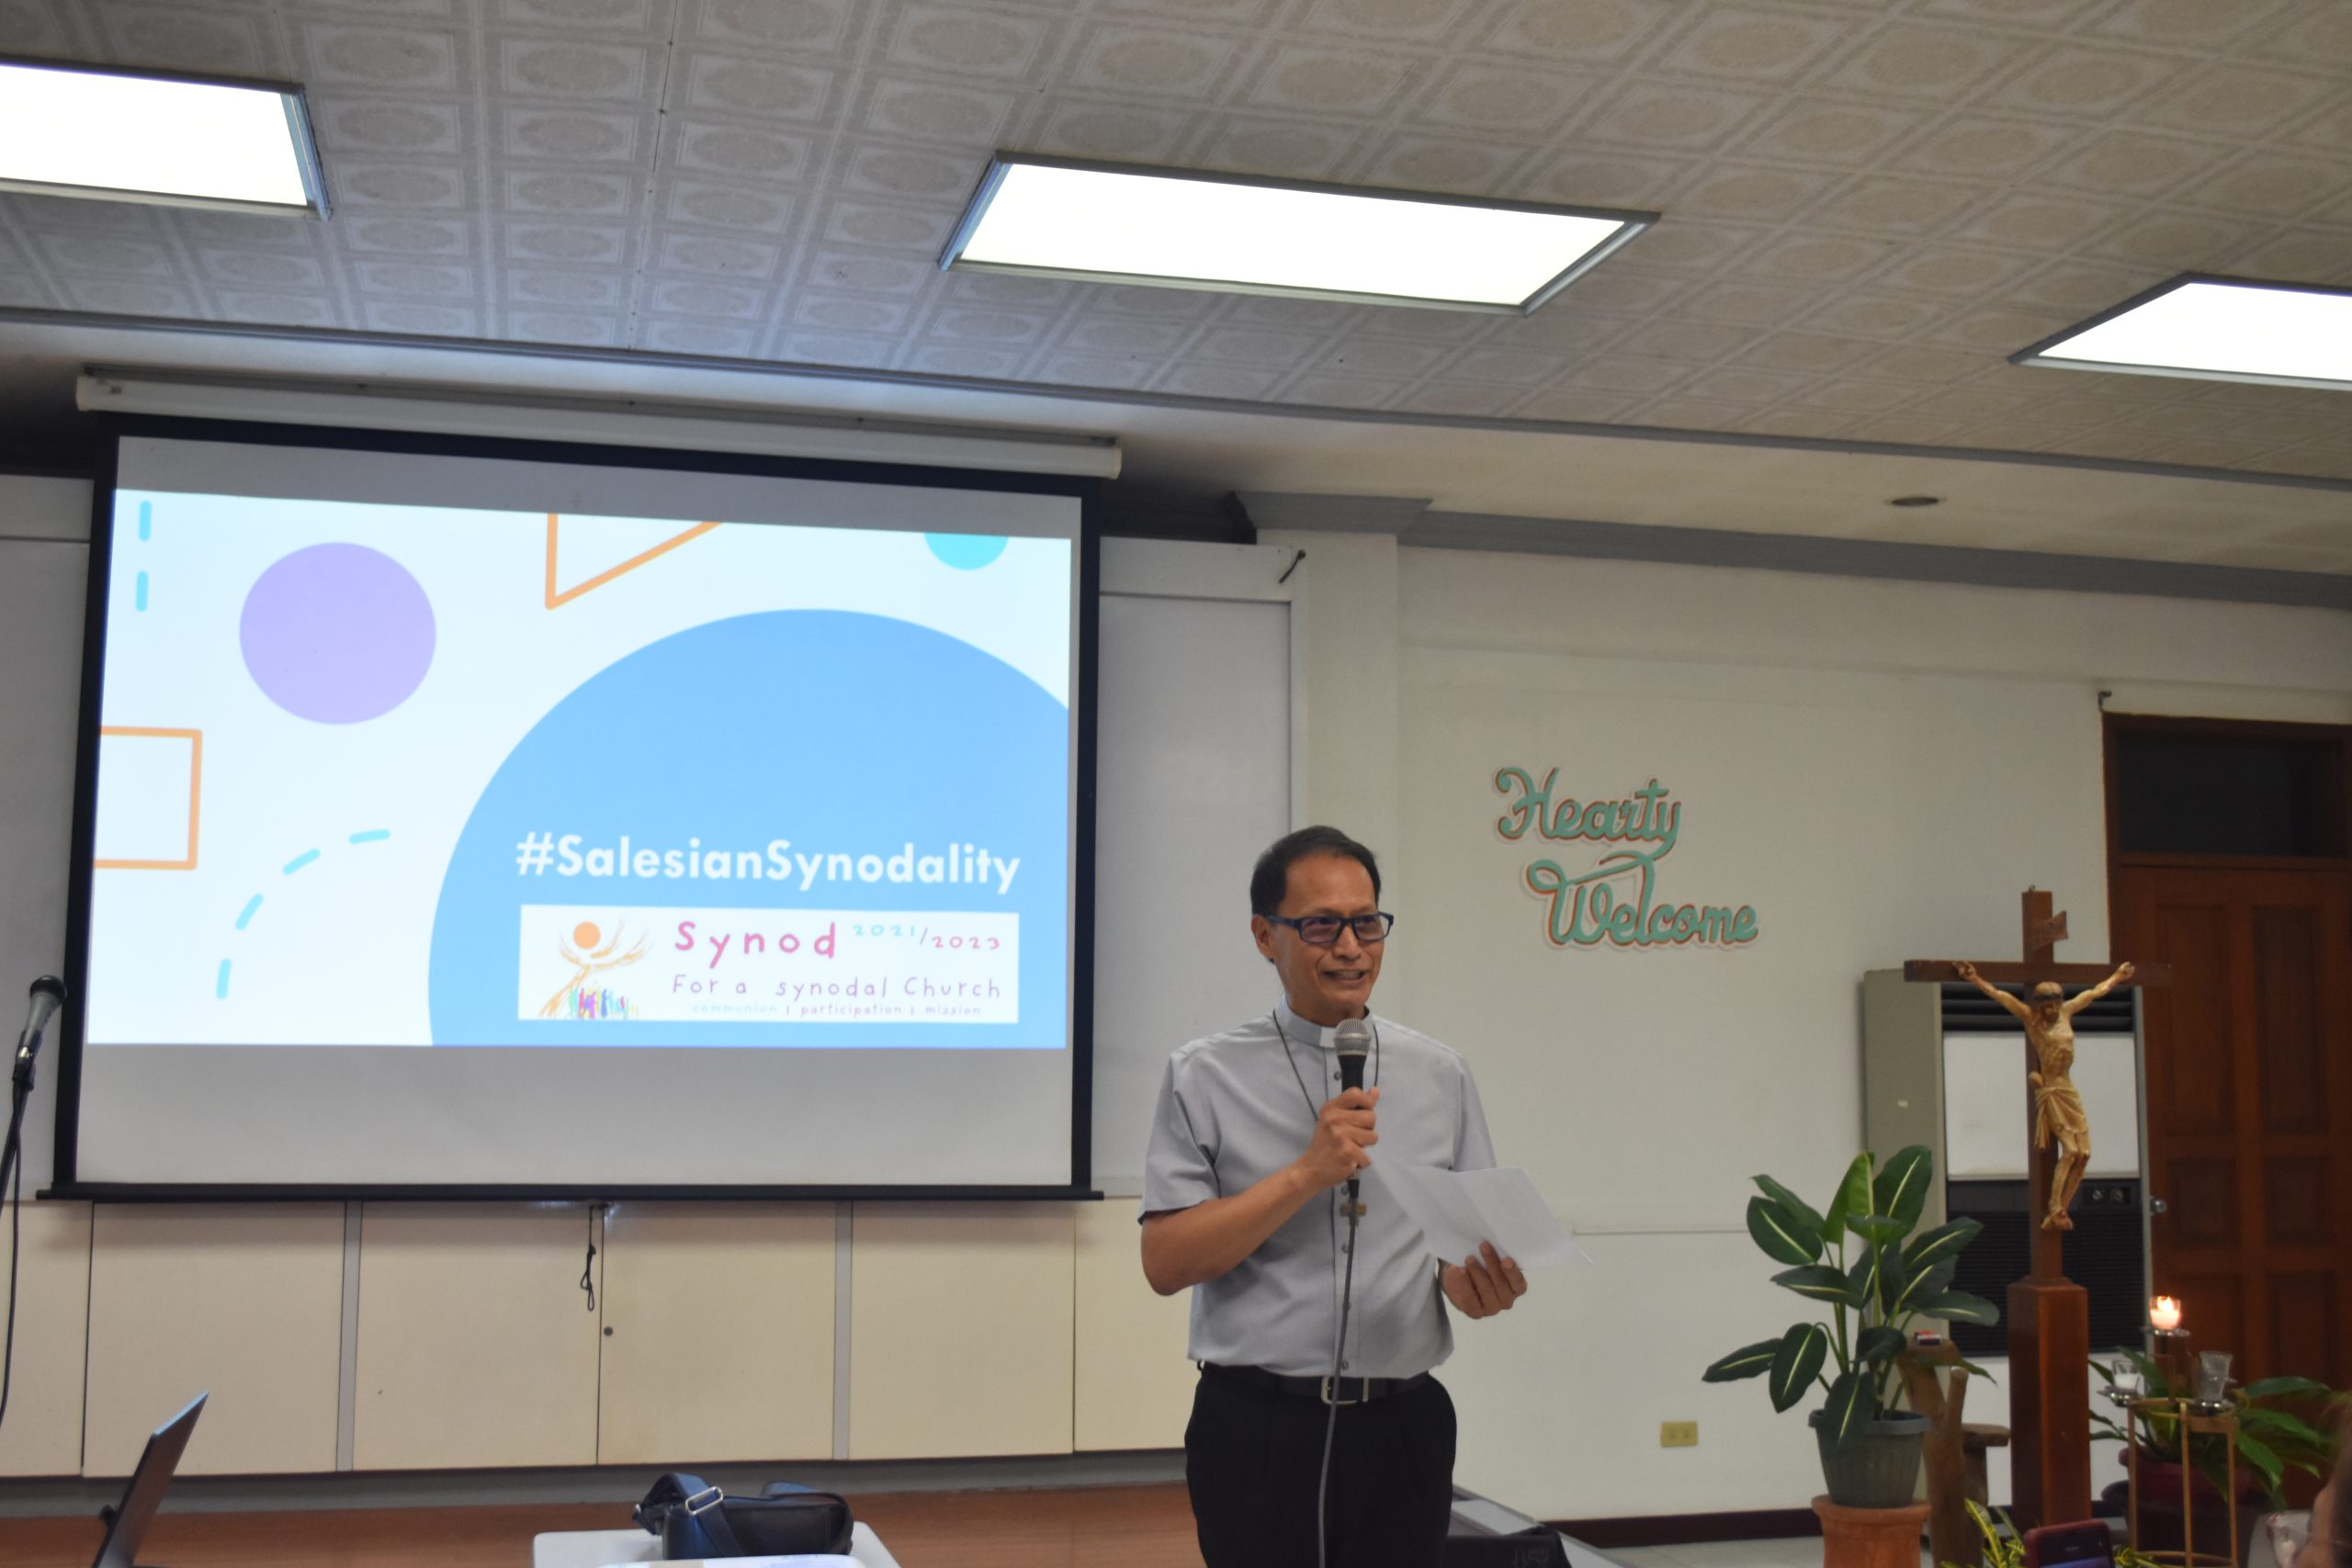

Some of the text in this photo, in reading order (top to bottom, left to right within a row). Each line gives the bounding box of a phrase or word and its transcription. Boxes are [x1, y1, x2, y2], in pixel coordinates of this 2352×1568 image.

[1494, 766, 1682, 863] Hearty
[515, 830, 1022, 895] #SalesianSynodality
[1525, 851, 1759, 947] Welcome
[674, 920, 836, 969] Synod
[673, 974, 1000, 1001] For a synodal Church
[693, 1003, 980, 1018] communion participation mission
